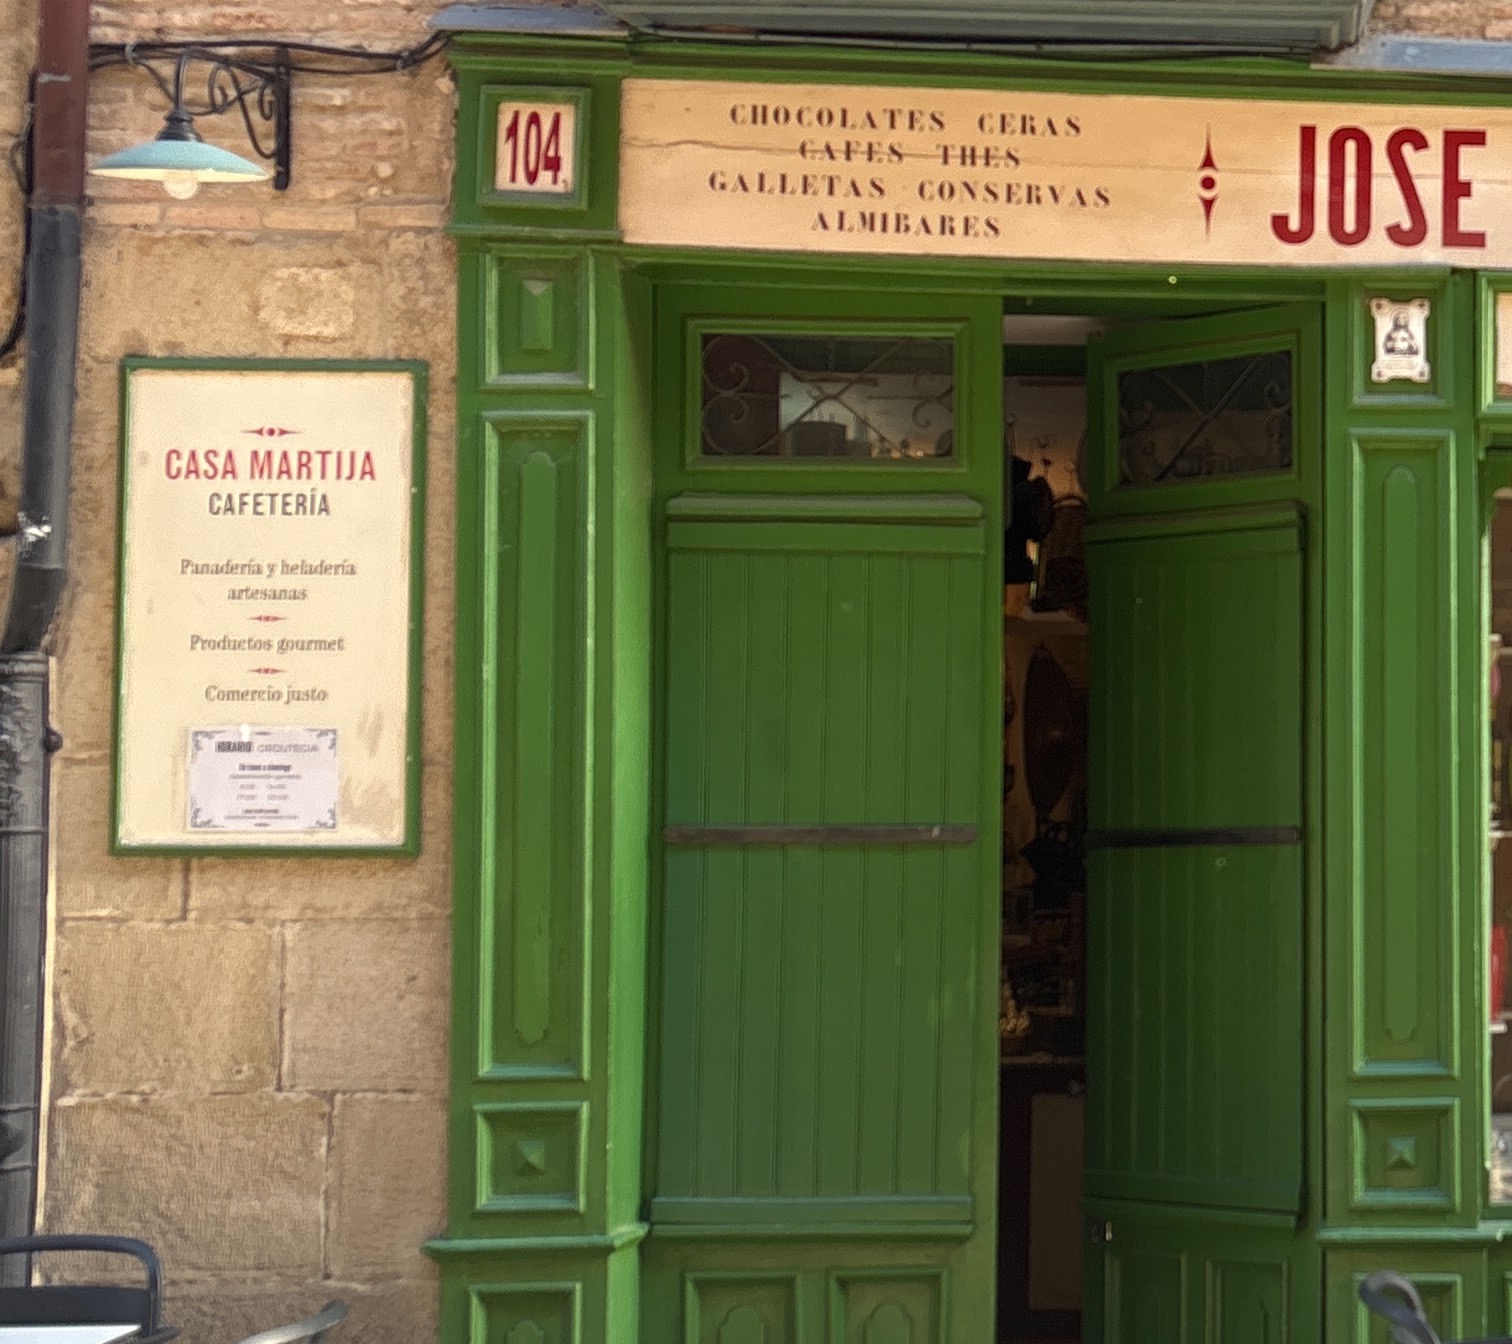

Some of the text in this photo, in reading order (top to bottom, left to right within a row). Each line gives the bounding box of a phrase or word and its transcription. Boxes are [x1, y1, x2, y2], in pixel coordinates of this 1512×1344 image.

[730, 105, 1080, 135] CHOCOLATES CERAS
[506, 110, 561, 185] 104
[799, 141, 1019, 167] CAFES THES
[709, 173, 1109, 206] GALLETAS CONSERVAS
[1272, 125, 1486, 248] JOSE
[812, 210, 1000, 237] ALMIBARES
[166, 449, 375, 480] CASA MARTIJA
[209, 488, 330, 516] CAFETERÍA
[181, 559, 356, 578] Panadería y heladería
[228, 587, 307, 600] artesanas
[191, 634, 344, 654] Productos gourmet
[205, 685, 328, 705] Comercio justo
